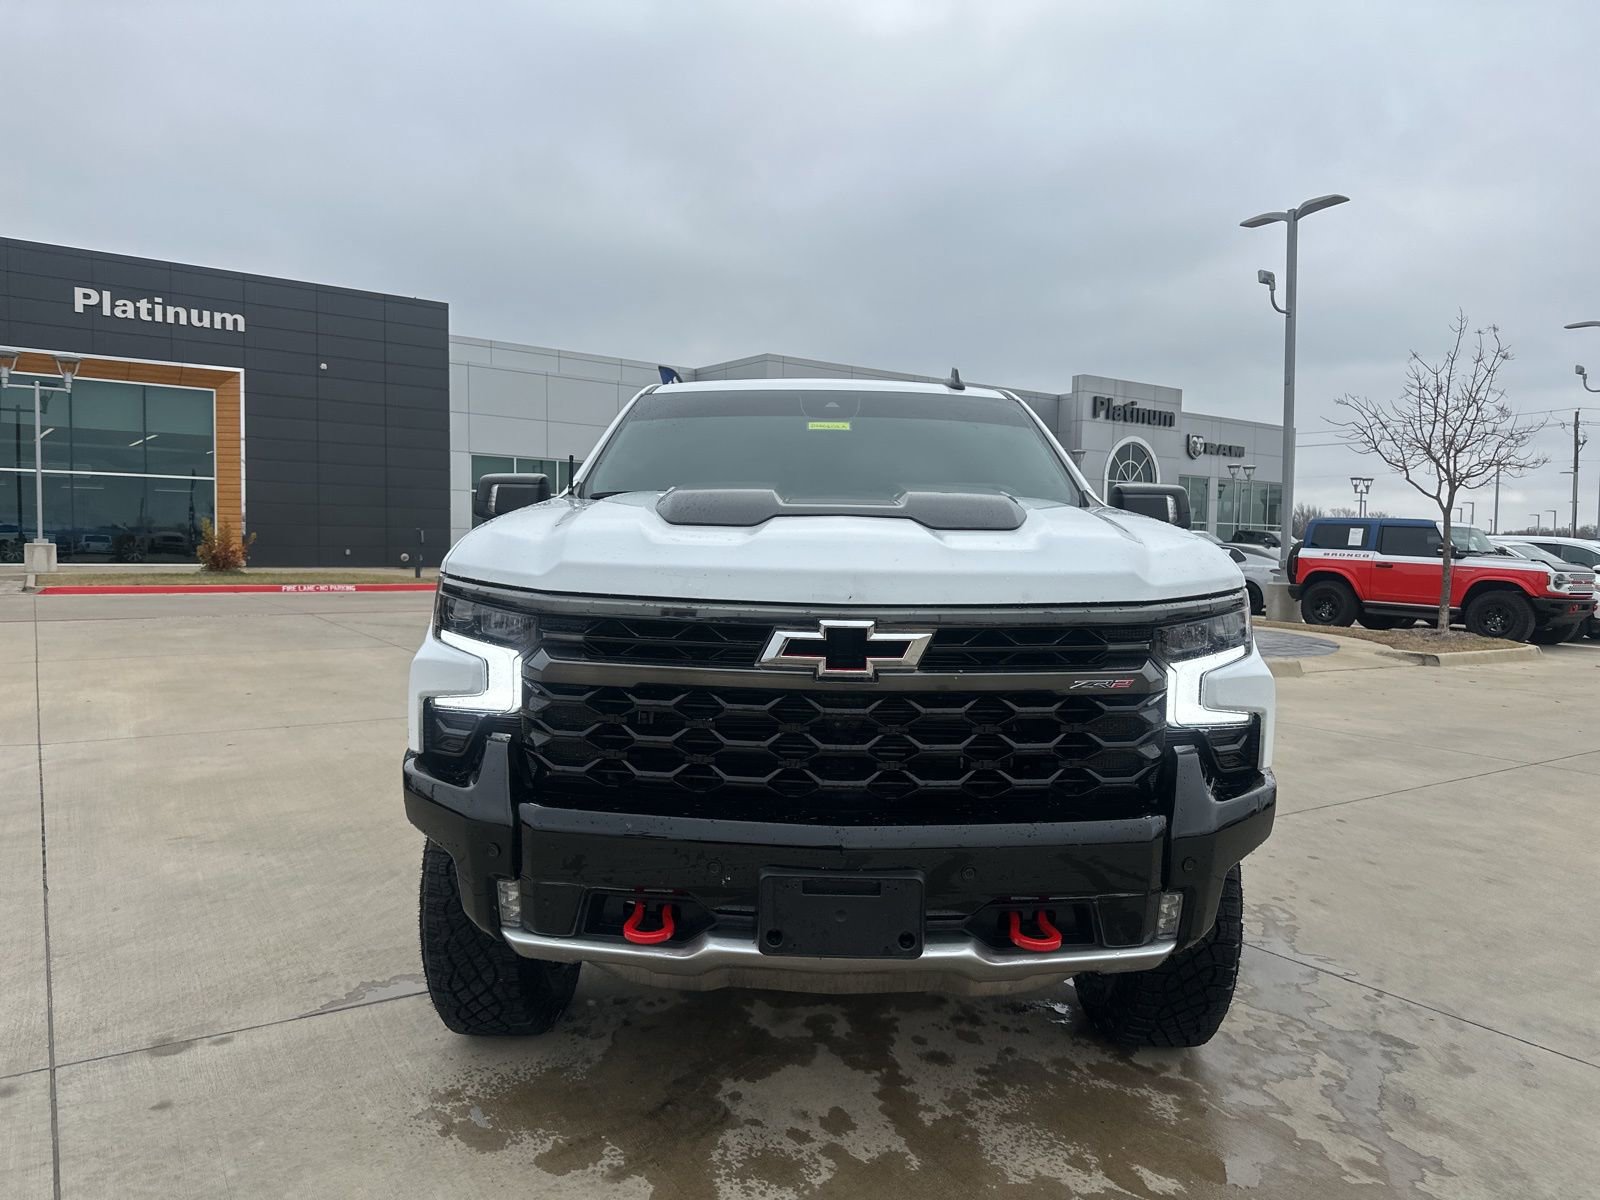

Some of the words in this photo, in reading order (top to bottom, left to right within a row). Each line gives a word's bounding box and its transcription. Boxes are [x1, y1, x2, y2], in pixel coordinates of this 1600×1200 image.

[73, 286, 246, 333] Platinum
[1092, 395, 1176, 428] Platinum
[1203, 442, 1246, 458] RAM
[281, 584, 298, 592] FIRE
[329, 584, 356, 592] PARKING
[1069, 679, 1135, 690] ZR2
